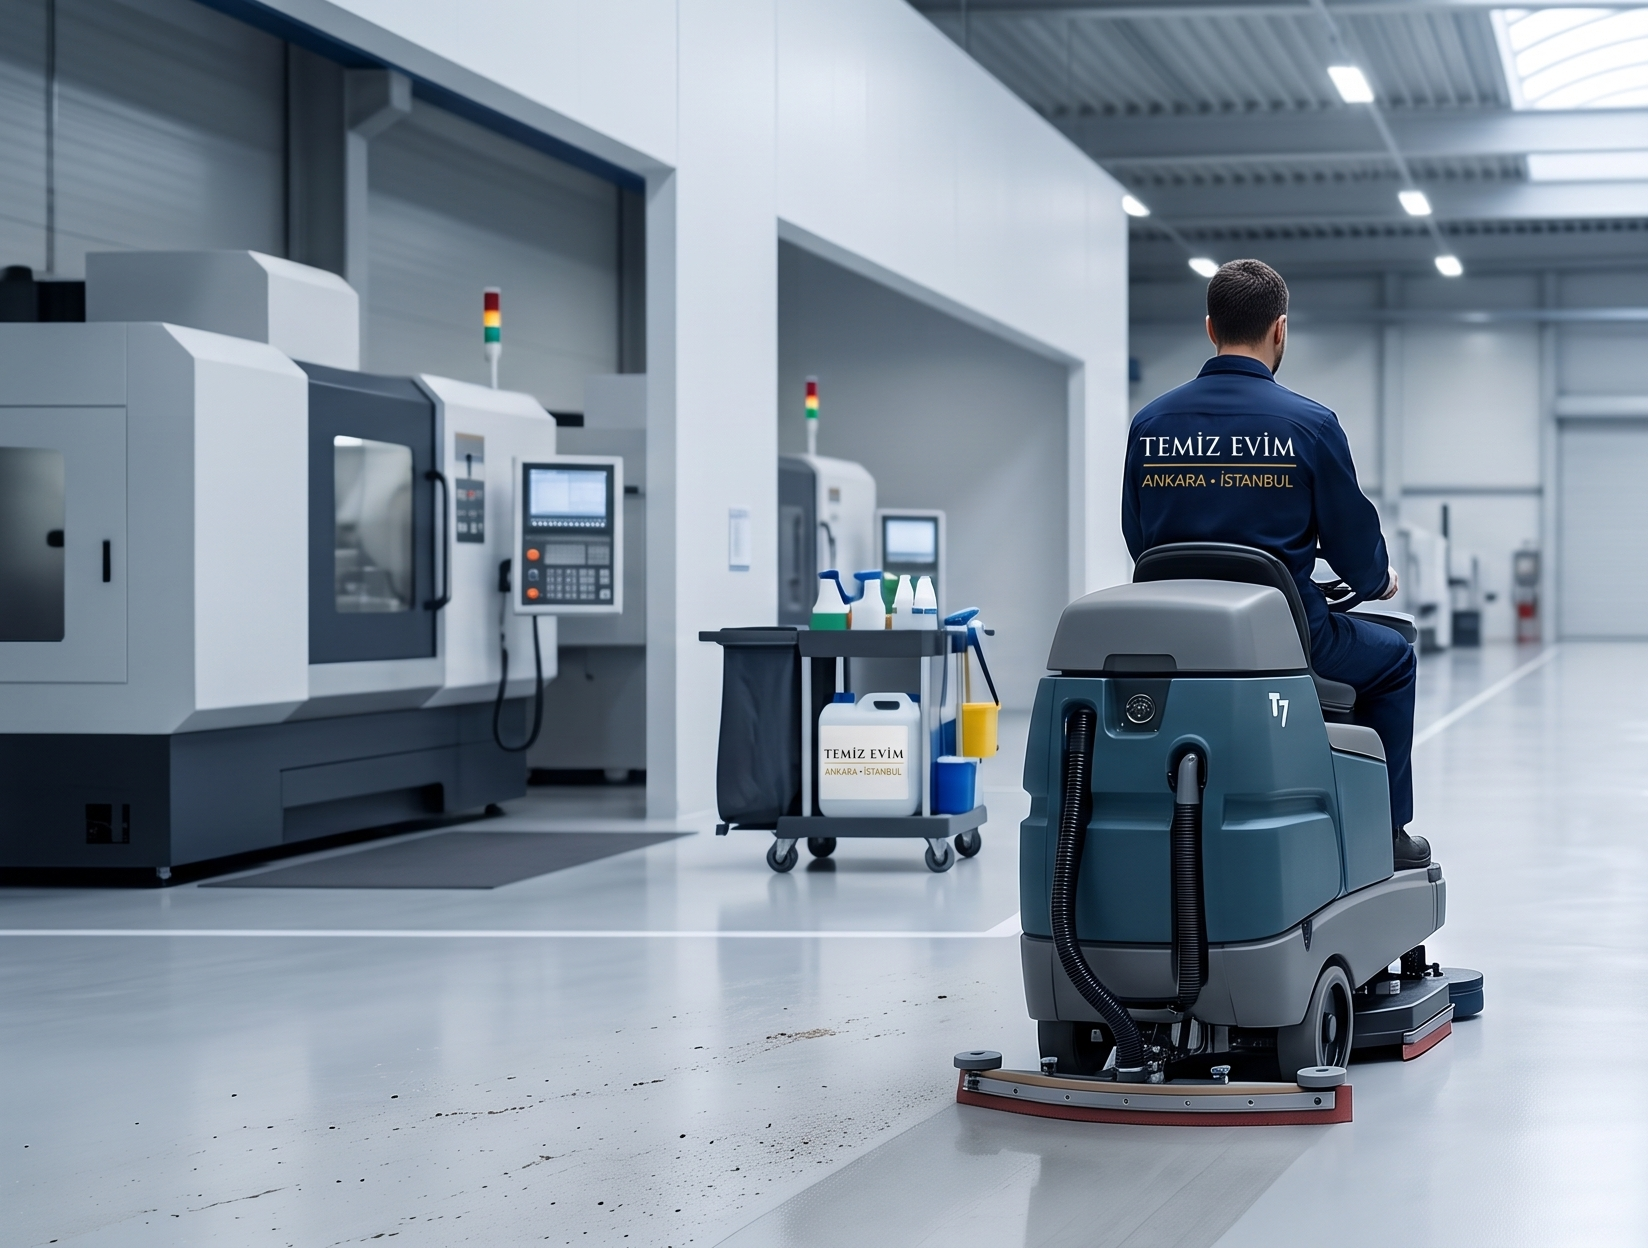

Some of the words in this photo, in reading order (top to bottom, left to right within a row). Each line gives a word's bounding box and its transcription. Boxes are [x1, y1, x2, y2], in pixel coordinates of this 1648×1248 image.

[1139, 431, 1221, 457] TEMİZ
[1231, 431, 1296, 457] EVİM
[1141, 473, 1206, 488] ANKARA
[1220, 470, 1294, 488] İSTANBUL
[823, 746, 866, 759] TEMİZ
[870, 746, 904, 759] EVİM
[824, 767, 858, 776] ANKARA
[863, 766, 902, 776] İSTANBUL
